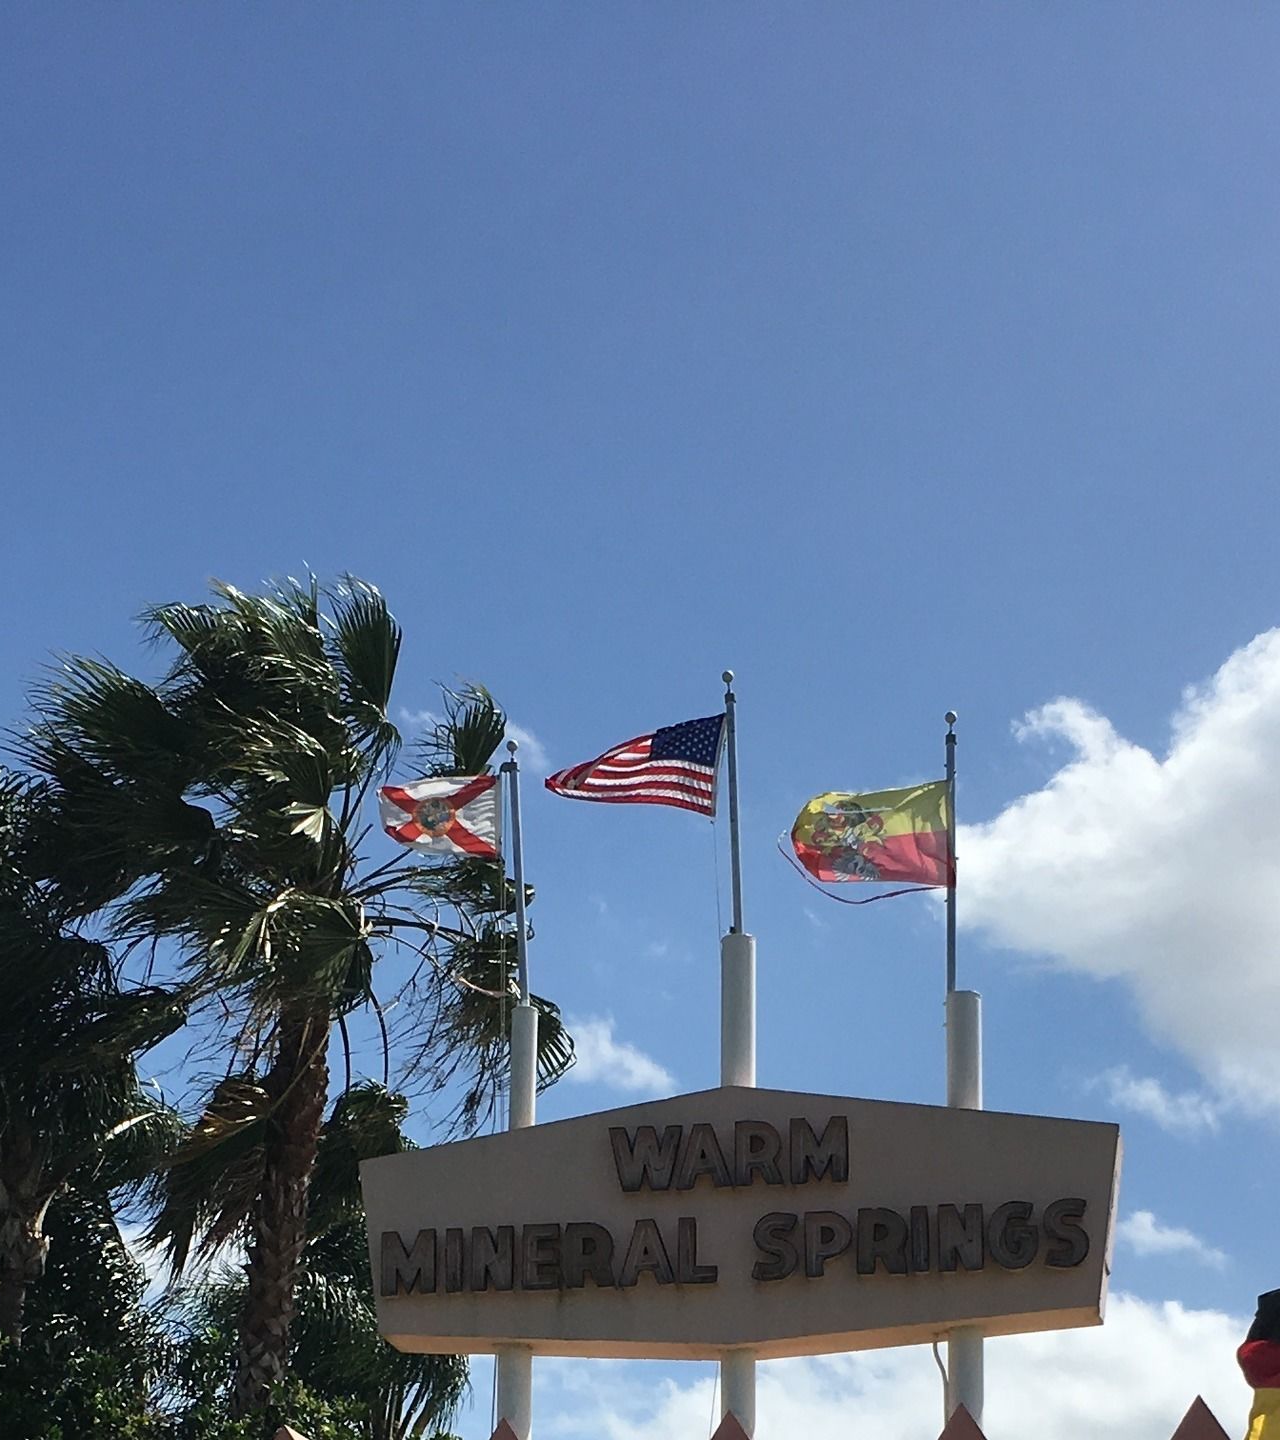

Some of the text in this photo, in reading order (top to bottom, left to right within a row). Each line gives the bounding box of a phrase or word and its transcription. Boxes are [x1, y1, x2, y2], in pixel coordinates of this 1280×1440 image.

[608, 1115, 849, 1192] WARM
[379, 1198, 1090, 1298] MINERAL SPRINGS
